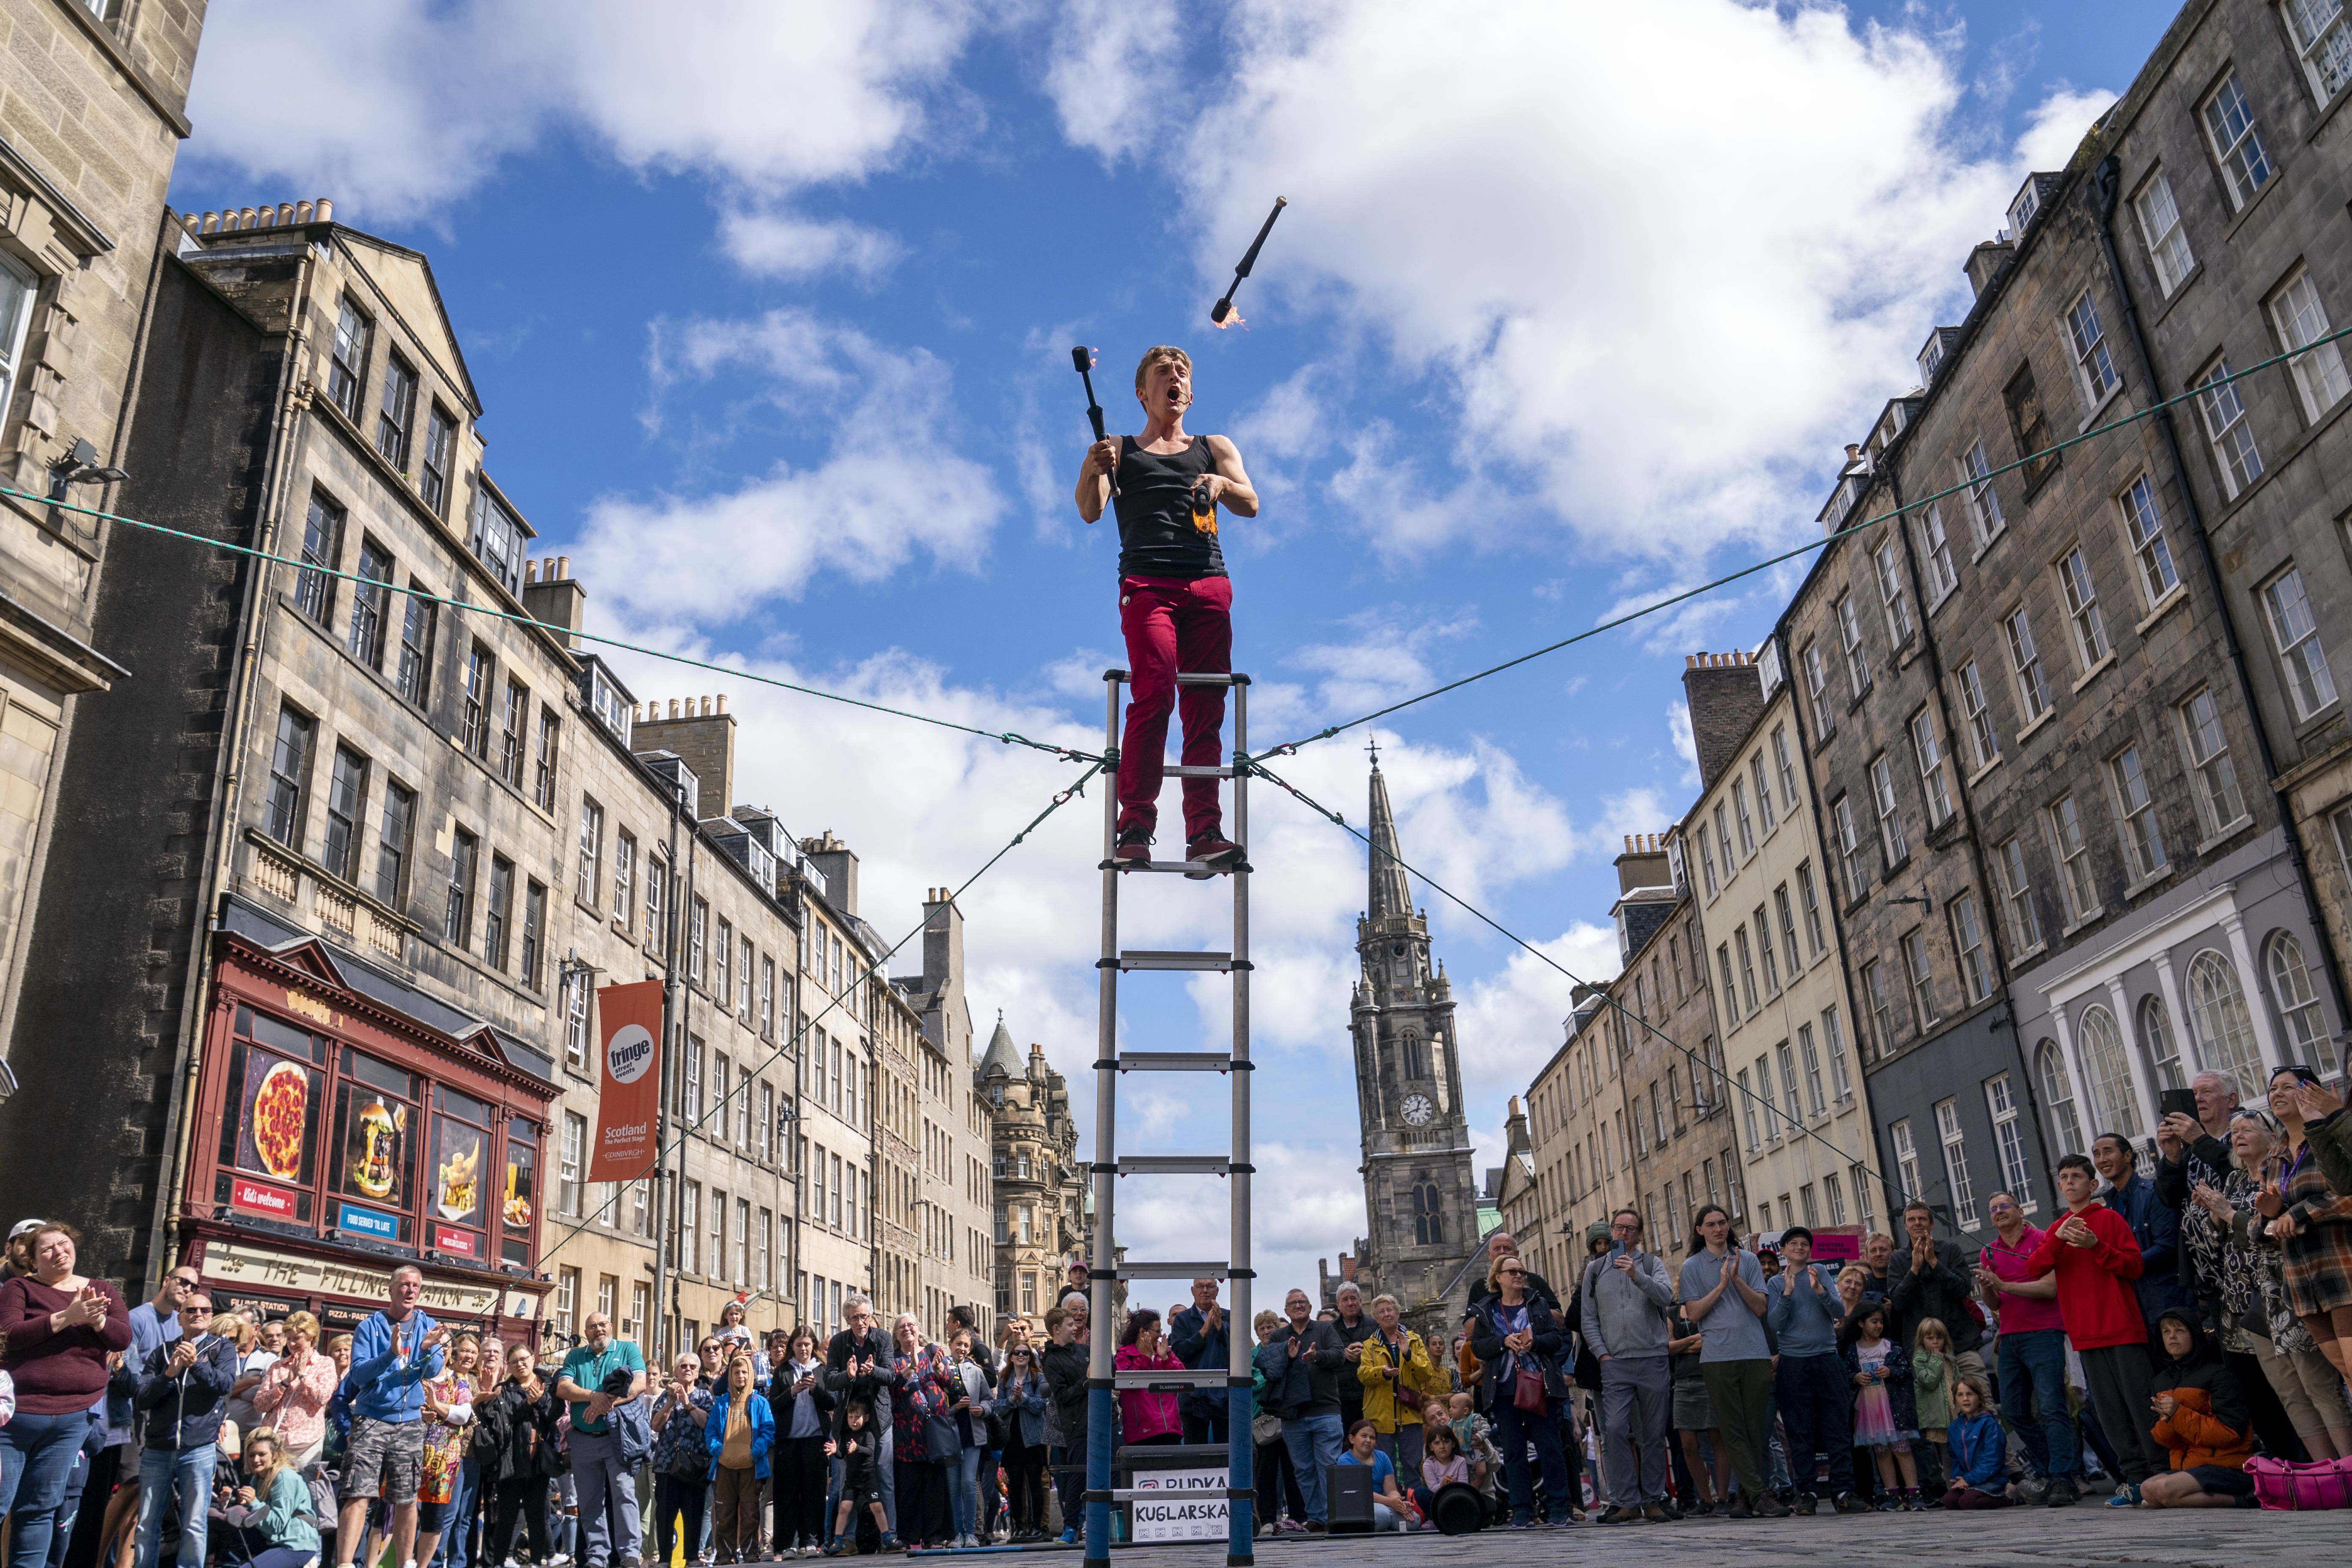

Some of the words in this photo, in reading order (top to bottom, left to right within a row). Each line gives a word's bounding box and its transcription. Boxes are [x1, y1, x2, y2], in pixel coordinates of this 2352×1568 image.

[611, 1040, 650, 1068] fringe
[615, 1062, 632, 1073] street
[615, 1067, 635, 1079] events
[605, 1121, 646, 1138] Scotland
[258, 1192, 285, 1209] welcome
[347, 1214, 358, 1225] FOOD
[358, 1216, 373, 1228] SERVED
[380, 1221, 390, 1232] LATE
[264, 1259, 302, 1285] THE
[319, 1267, 390, 1297] FILLING
[417, 1285, 464, 1307] TATION
[260, 1301, 290, 1312] STATION
[328, 1310, 348, 1318] PIZZA
[351, 1312, 370, 1320] PAST
[1135, 1503, 1229, 1522] KUGLARSKA
